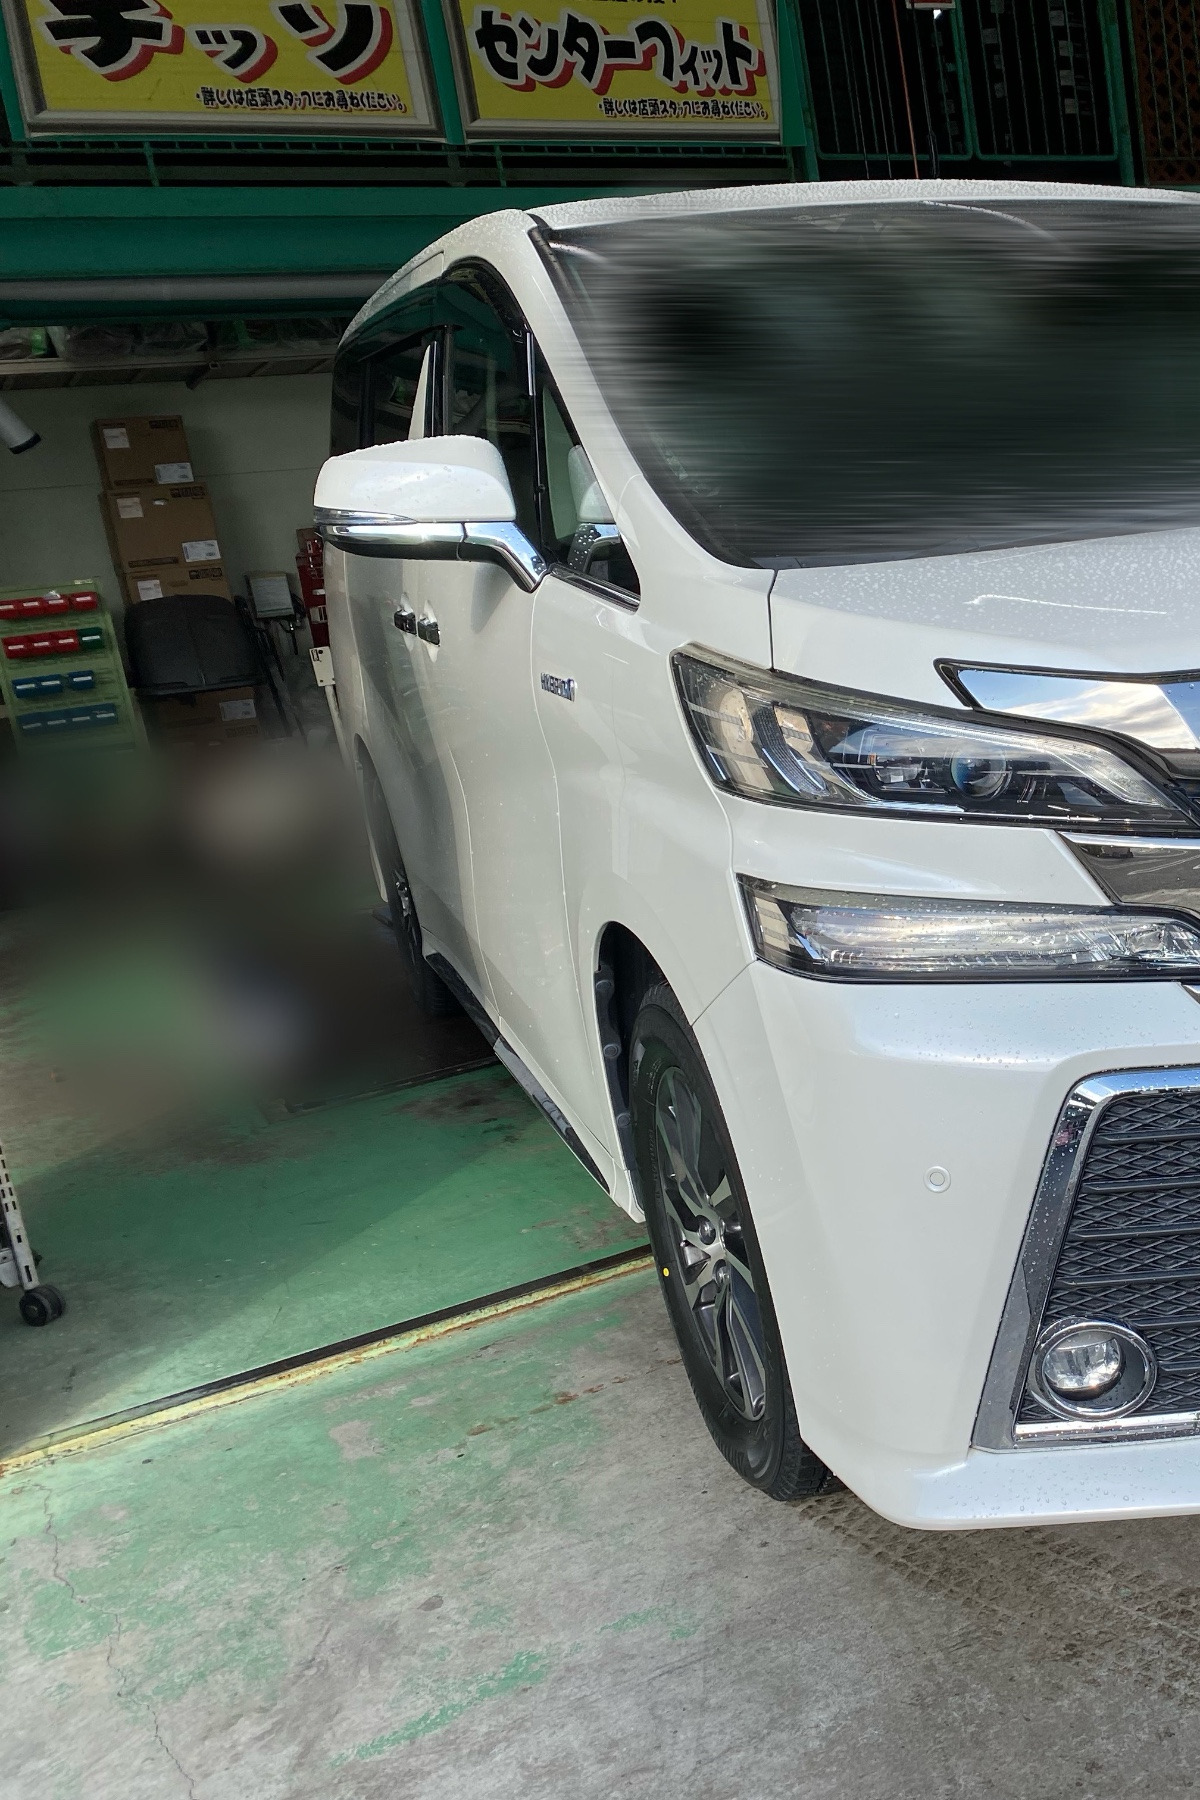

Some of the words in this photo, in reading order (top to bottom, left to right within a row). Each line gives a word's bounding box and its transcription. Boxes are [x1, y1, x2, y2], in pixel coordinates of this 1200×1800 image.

[472, 8, 757, 90] センターフィット
